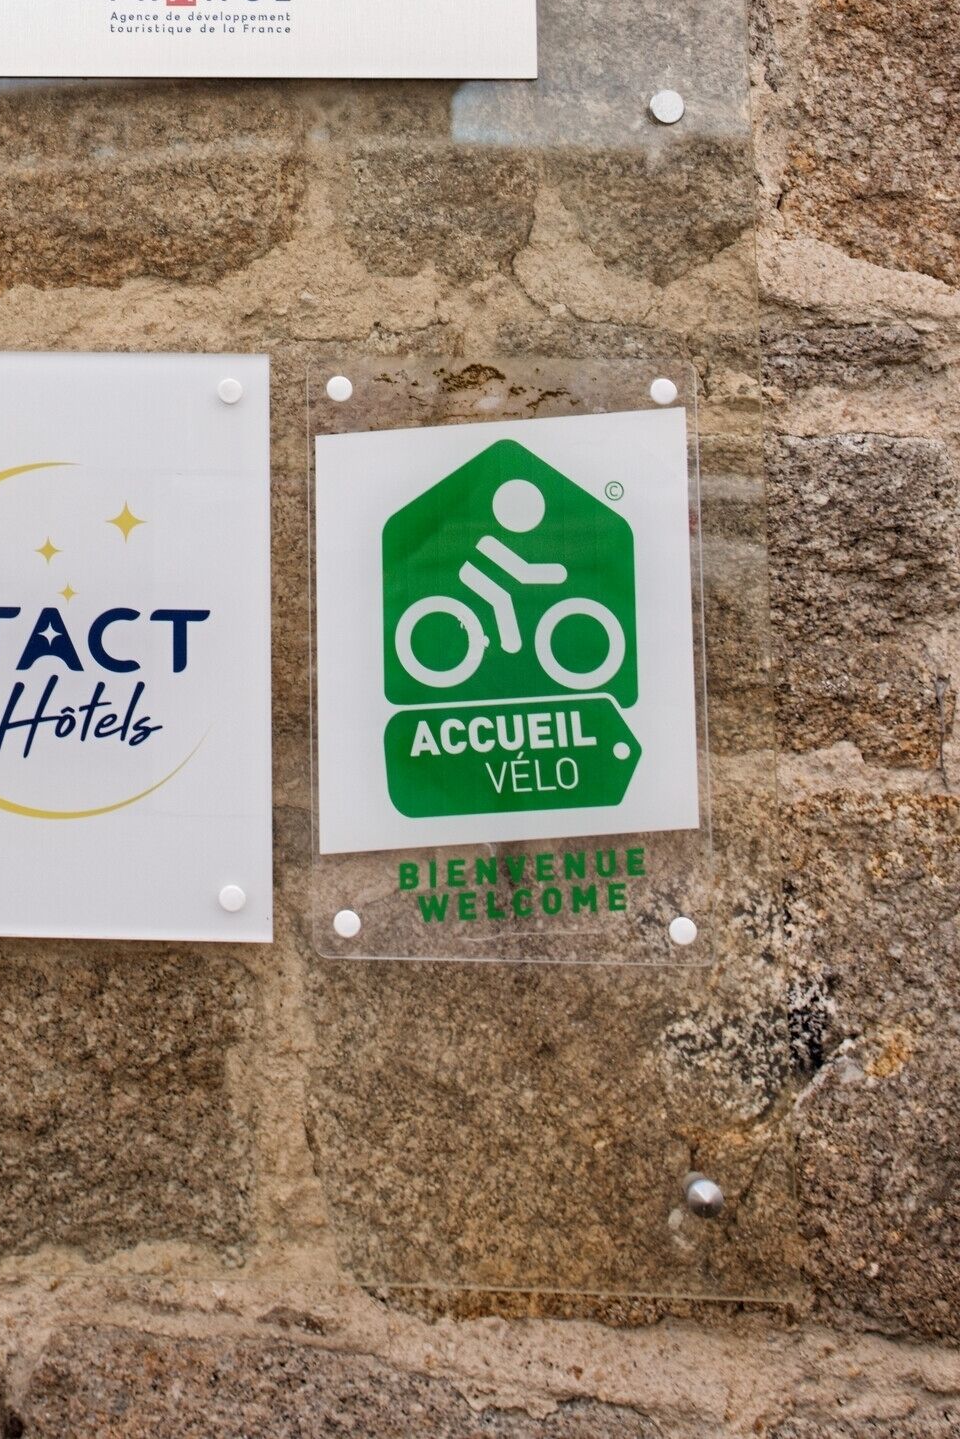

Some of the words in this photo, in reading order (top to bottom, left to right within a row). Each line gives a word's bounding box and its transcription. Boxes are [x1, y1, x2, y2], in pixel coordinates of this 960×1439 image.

[110, 12, 159, 23] Agence
[166, 12, 181, 22] de
[187, 12, 291, 23] développement
[110, 24, 193, 35] touristique
[200, 24, 216, 34] de
[223, 24, 236, 34] la
[243, 24, 291, 34] France
[410, 710, 597, 757] ACCUEIL
[485, 752, 580, 795] VÉLO
[398, 848, 648, 892] BIENVENUE
[418, 883, 628, 924] WELCOME
